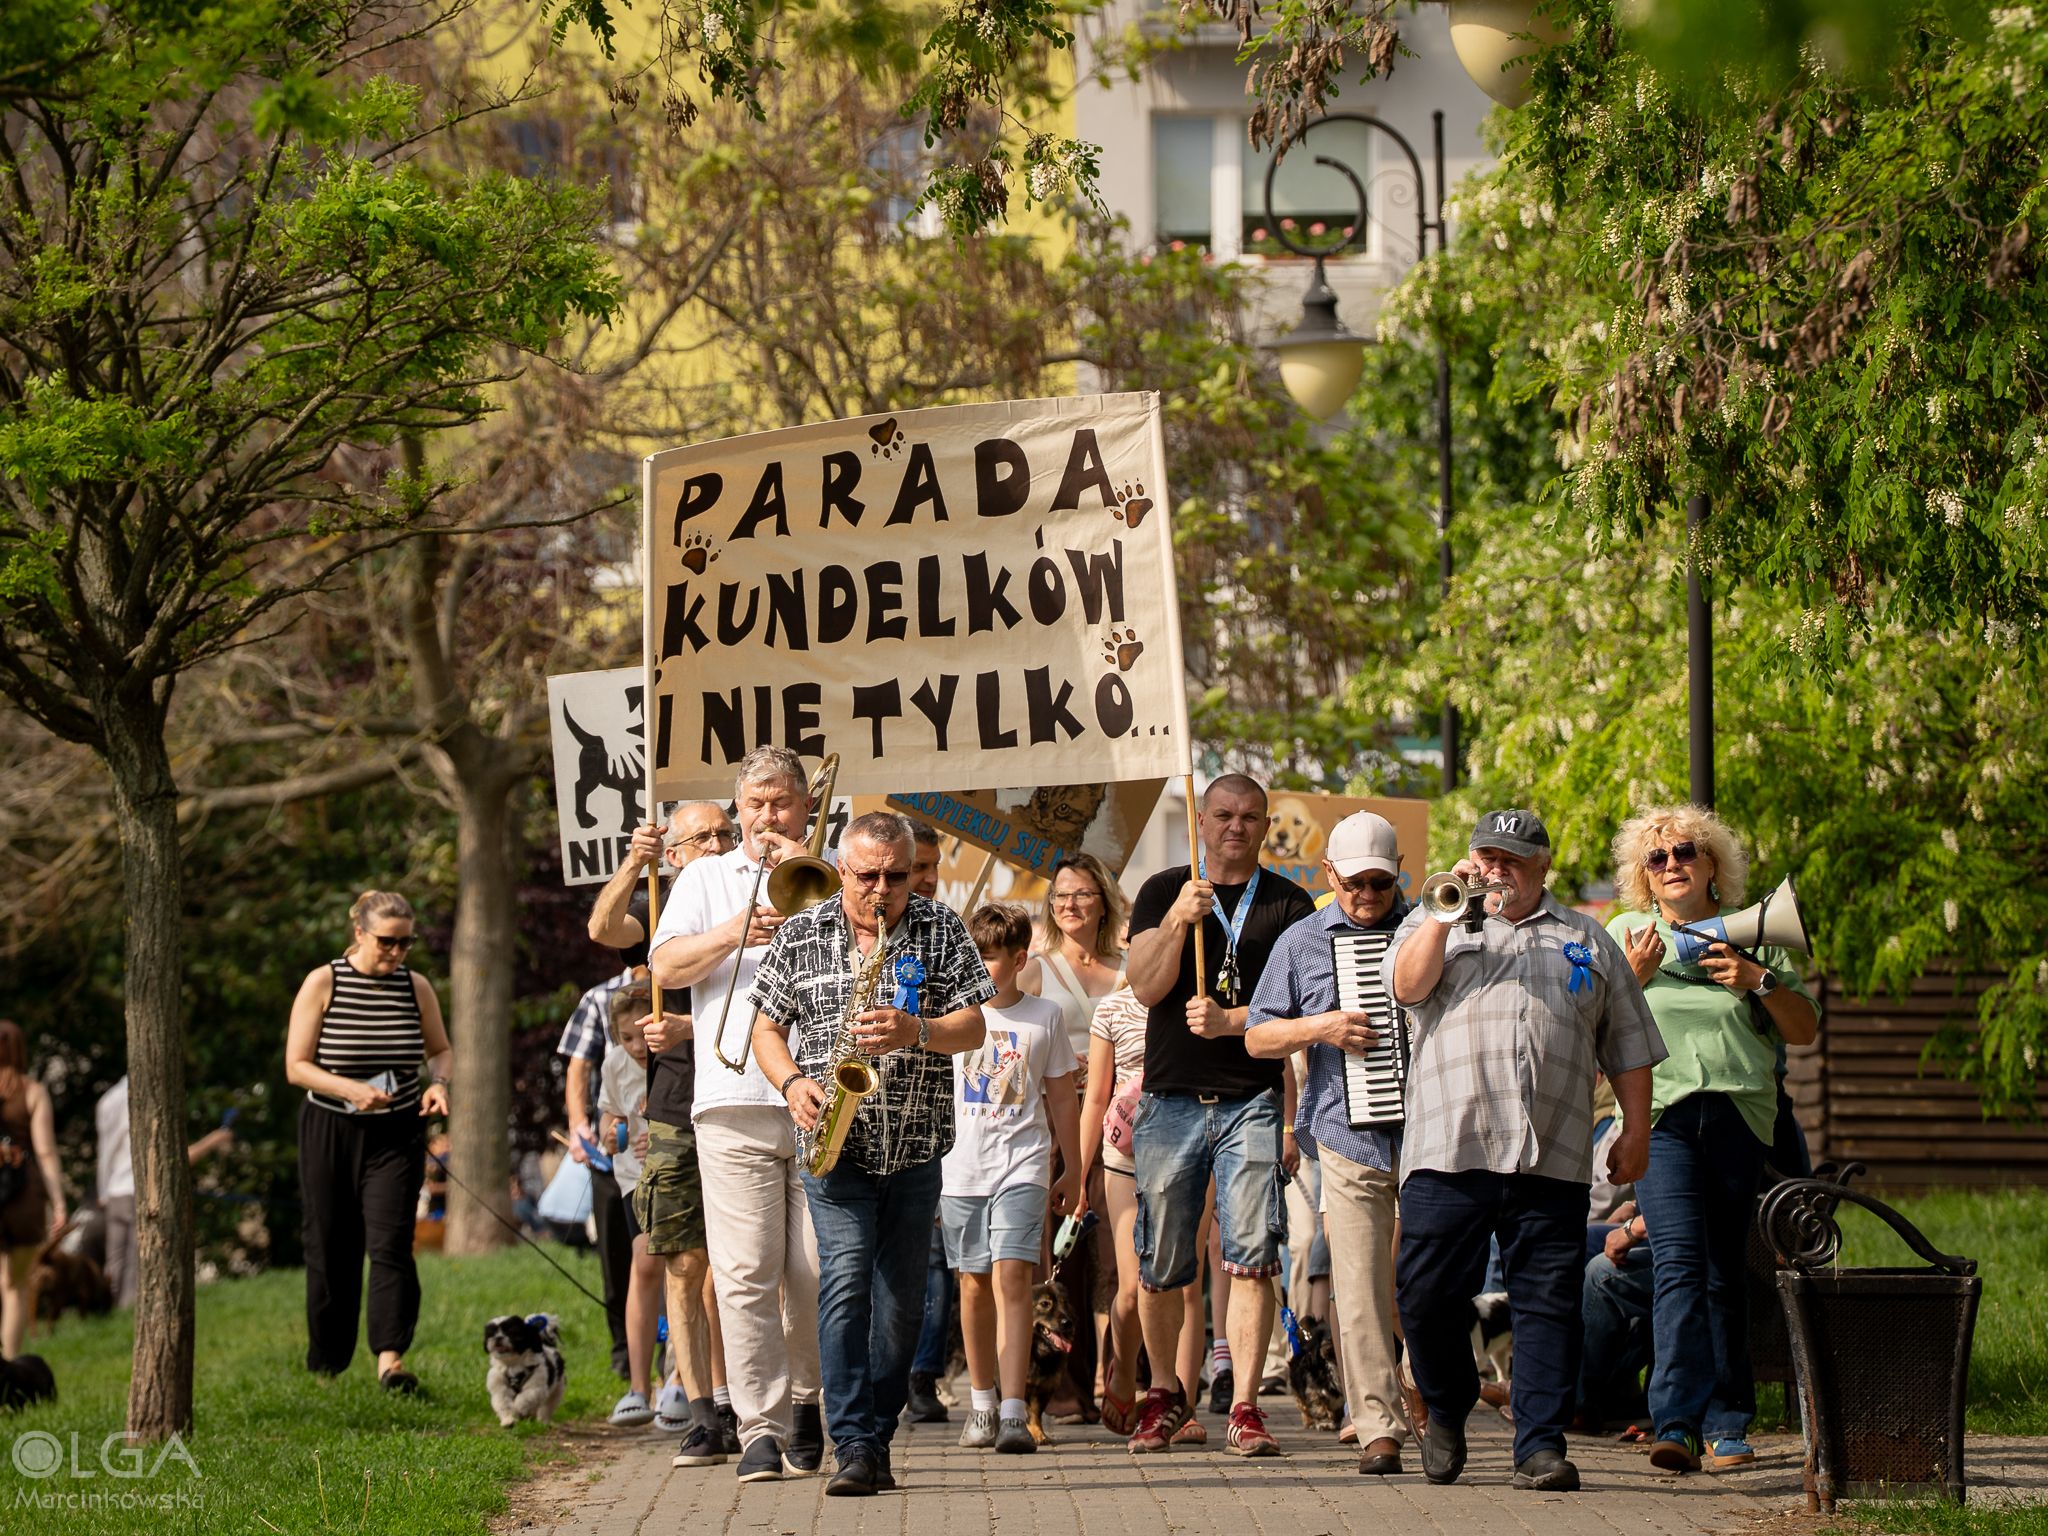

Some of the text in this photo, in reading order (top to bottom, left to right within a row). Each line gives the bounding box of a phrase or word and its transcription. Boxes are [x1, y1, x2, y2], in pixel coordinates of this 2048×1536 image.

[674, 429, 1120, 547] PARADA
[661, 525, 1126, 663] KUNDELKÓW
[655, 665, 1170, 769] I NIE TYLKO...
[1494, 815, 1519, 834] M
